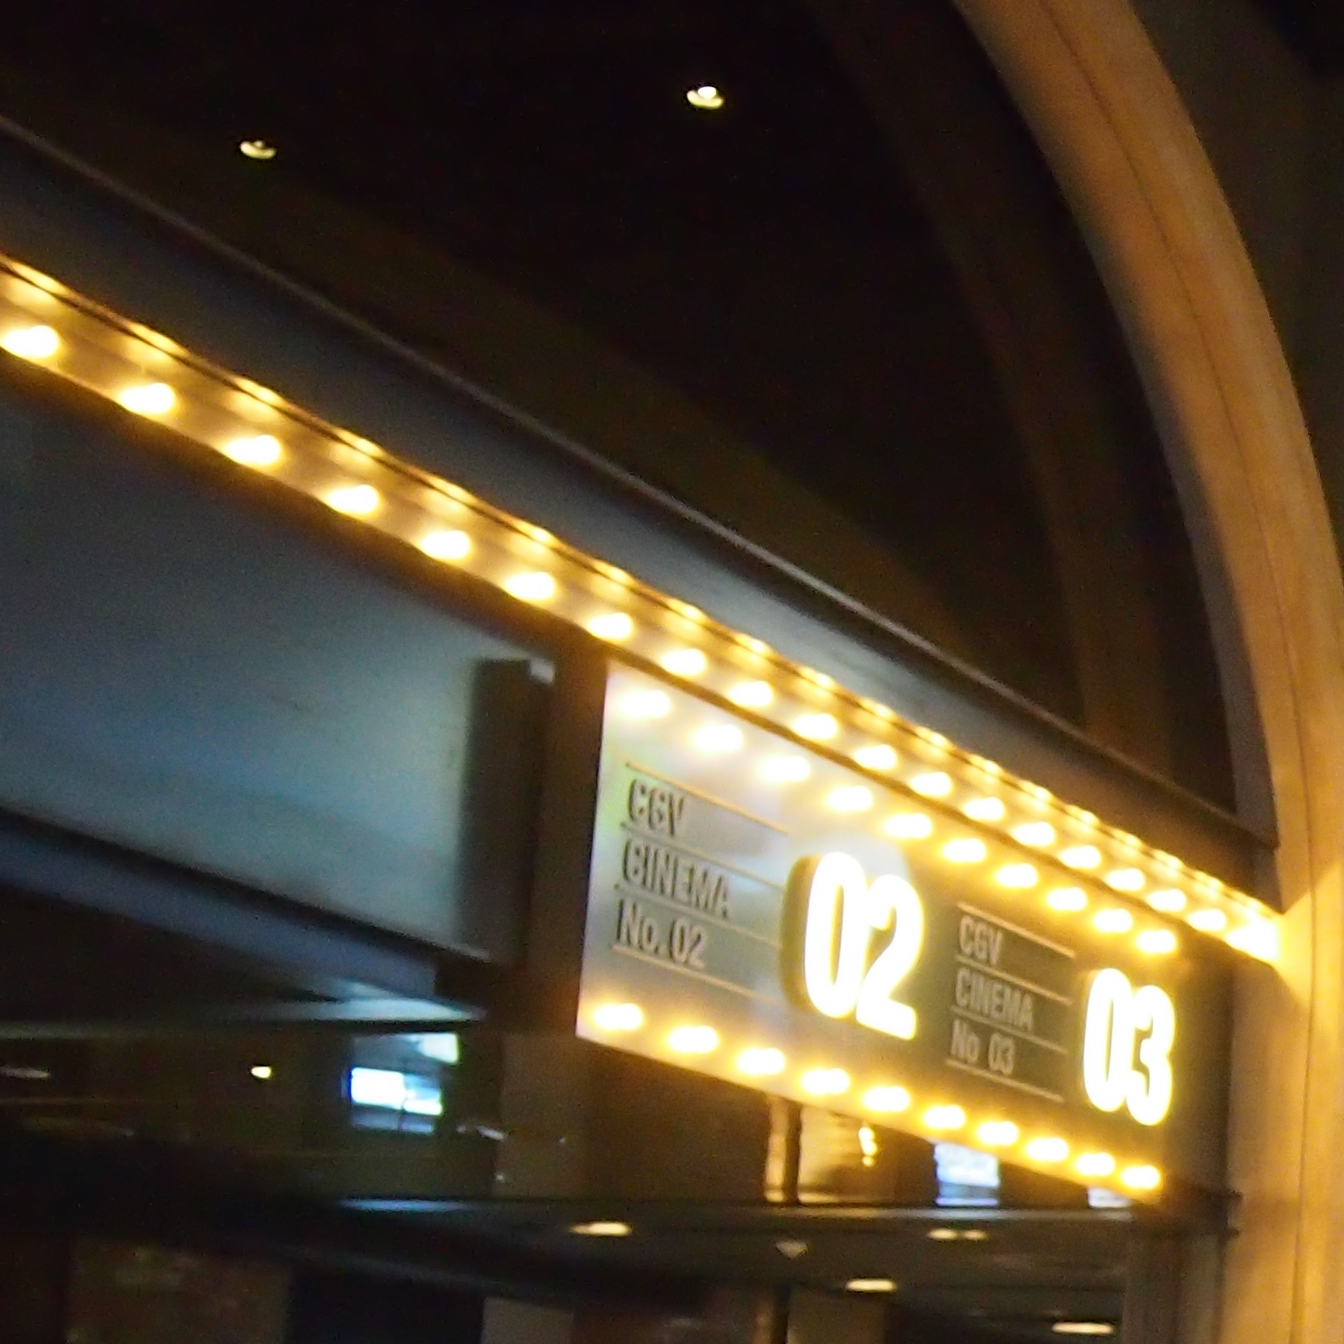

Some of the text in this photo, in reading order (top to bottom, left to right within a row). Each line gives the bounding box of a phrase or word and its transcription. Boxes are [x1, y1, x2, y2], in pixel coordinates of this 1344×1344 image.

[628, 779, 686, 837] CGV
[622, 838, 731, 920] CINEMA
[669, 915, 707, 970] 02
[803, 851, 925, 1041] 02
[959, 914, 1004, 964] CGV
[955, 966, 1034, 1033] CINEMA
[988, 1031, 1016, 1077] 03
[1082, 966, 1175, 1126] 03
